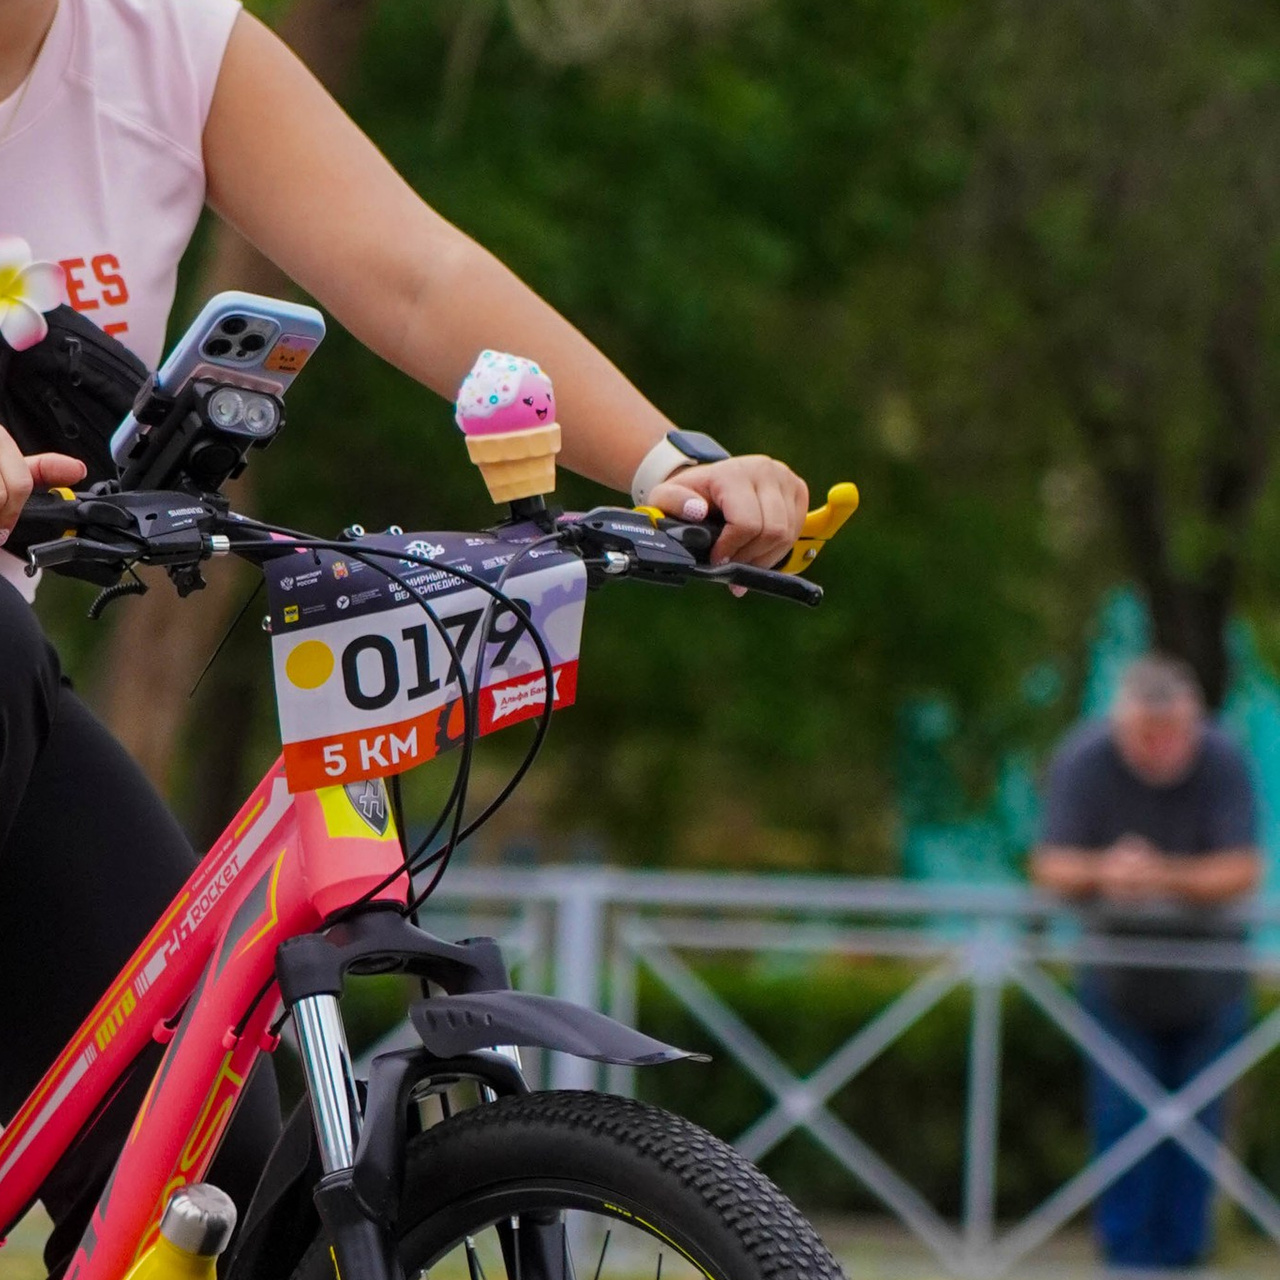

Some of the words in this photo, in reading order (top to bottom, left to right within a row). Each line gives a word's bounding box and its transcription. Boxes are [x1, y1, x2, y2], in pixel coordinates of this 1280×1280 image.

[611, 523, 655, 536] SHIMANO
[341, 597, 531, 710] 0179
[530, 685, 548, 696] Бан
[323, 743, 347, 777] 5
